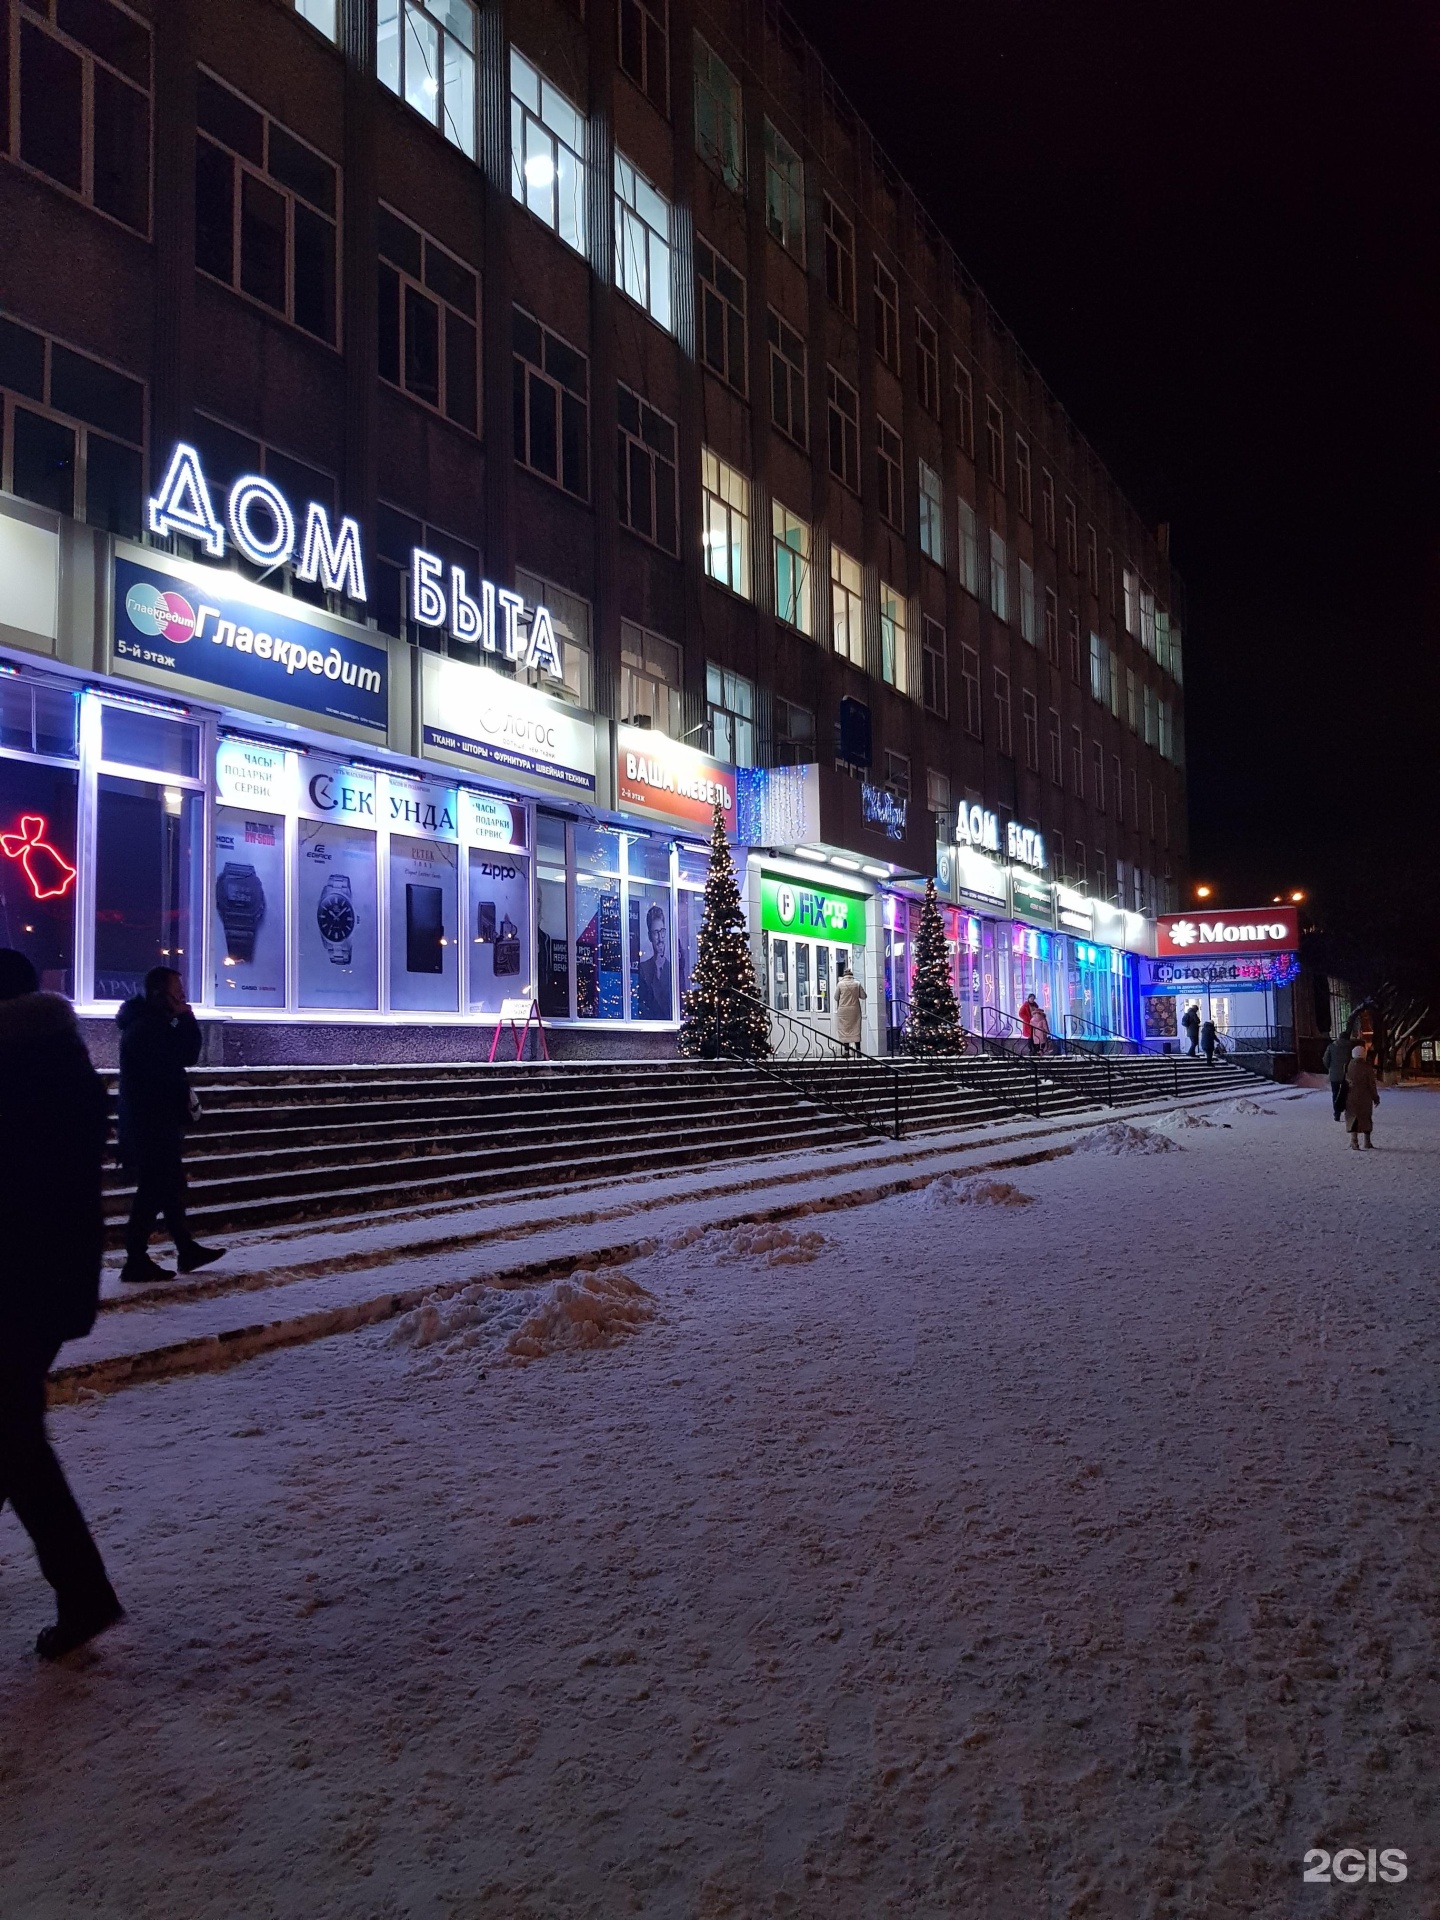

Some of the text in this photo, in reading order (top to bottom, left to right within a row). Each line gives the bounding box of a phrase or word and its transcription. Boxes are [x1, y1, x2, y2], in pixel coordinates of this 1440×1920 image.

[148, 443, 564, 678] ДОМ БЫТА
[127, 598, 195, 628] Главкредит
[117, 640, 176, 668] 5-й этаж
[194, 604, 382, 694] Главкредит
[503, 713, 555, 748] ЛОГОС
[243, 753, 273, 769] ЧАСЫ
[431, 733, 590, 787] ТКАНИ ШТОРЫ ФУРНИТУРА ШВЕЙНАЯ ТЕХНИКА
[224, 764, 273, 783] ПОДАРКИ
[626, 752, 732, 810] ВАША МЕБЕЛЬ
[233, 781, 273, 798] СЕРВИС
[621, 787, 646, 803] 2-й этаж
[475, 802, 496, 815] ЧАСЫ
[475, 814, 510, 829] ПОДАРКИ
[475, 827, 503, 840] СЕРВИС
[955, 799, 999, 851] ДОМ
[1006, 820, 1048, 869] БЫТА
[306, 851, 333, 861] EDIFICE
[411, 847, 435, 861] PETEK
[1198, 921, 1288, 944] Monro
